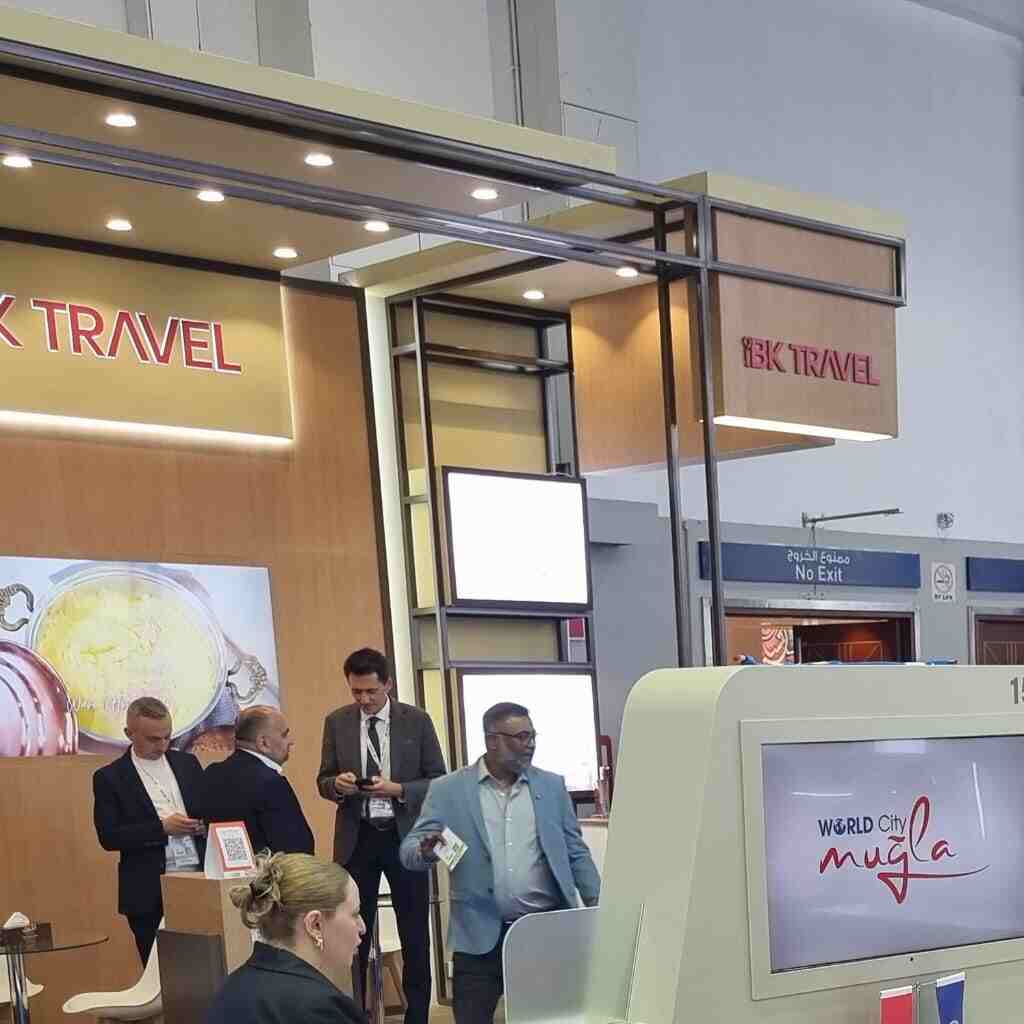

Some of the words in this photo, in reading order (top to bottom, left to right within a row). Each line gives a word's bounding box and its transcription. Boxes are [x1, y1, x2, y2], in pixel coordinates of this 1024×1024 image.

[31, 298, 243, 375] TRAVEL
[789, 344, 881, 386] TRAVEL
[787, 549, 818, 563] الخروج
[820, 551, 850, 565] ممنوع
[795, 563, 814, 581] No
[818, 565, 843, 582] Exit
[818, 815, 874, 837] WORLD
[878, 814, 907, 835] City
